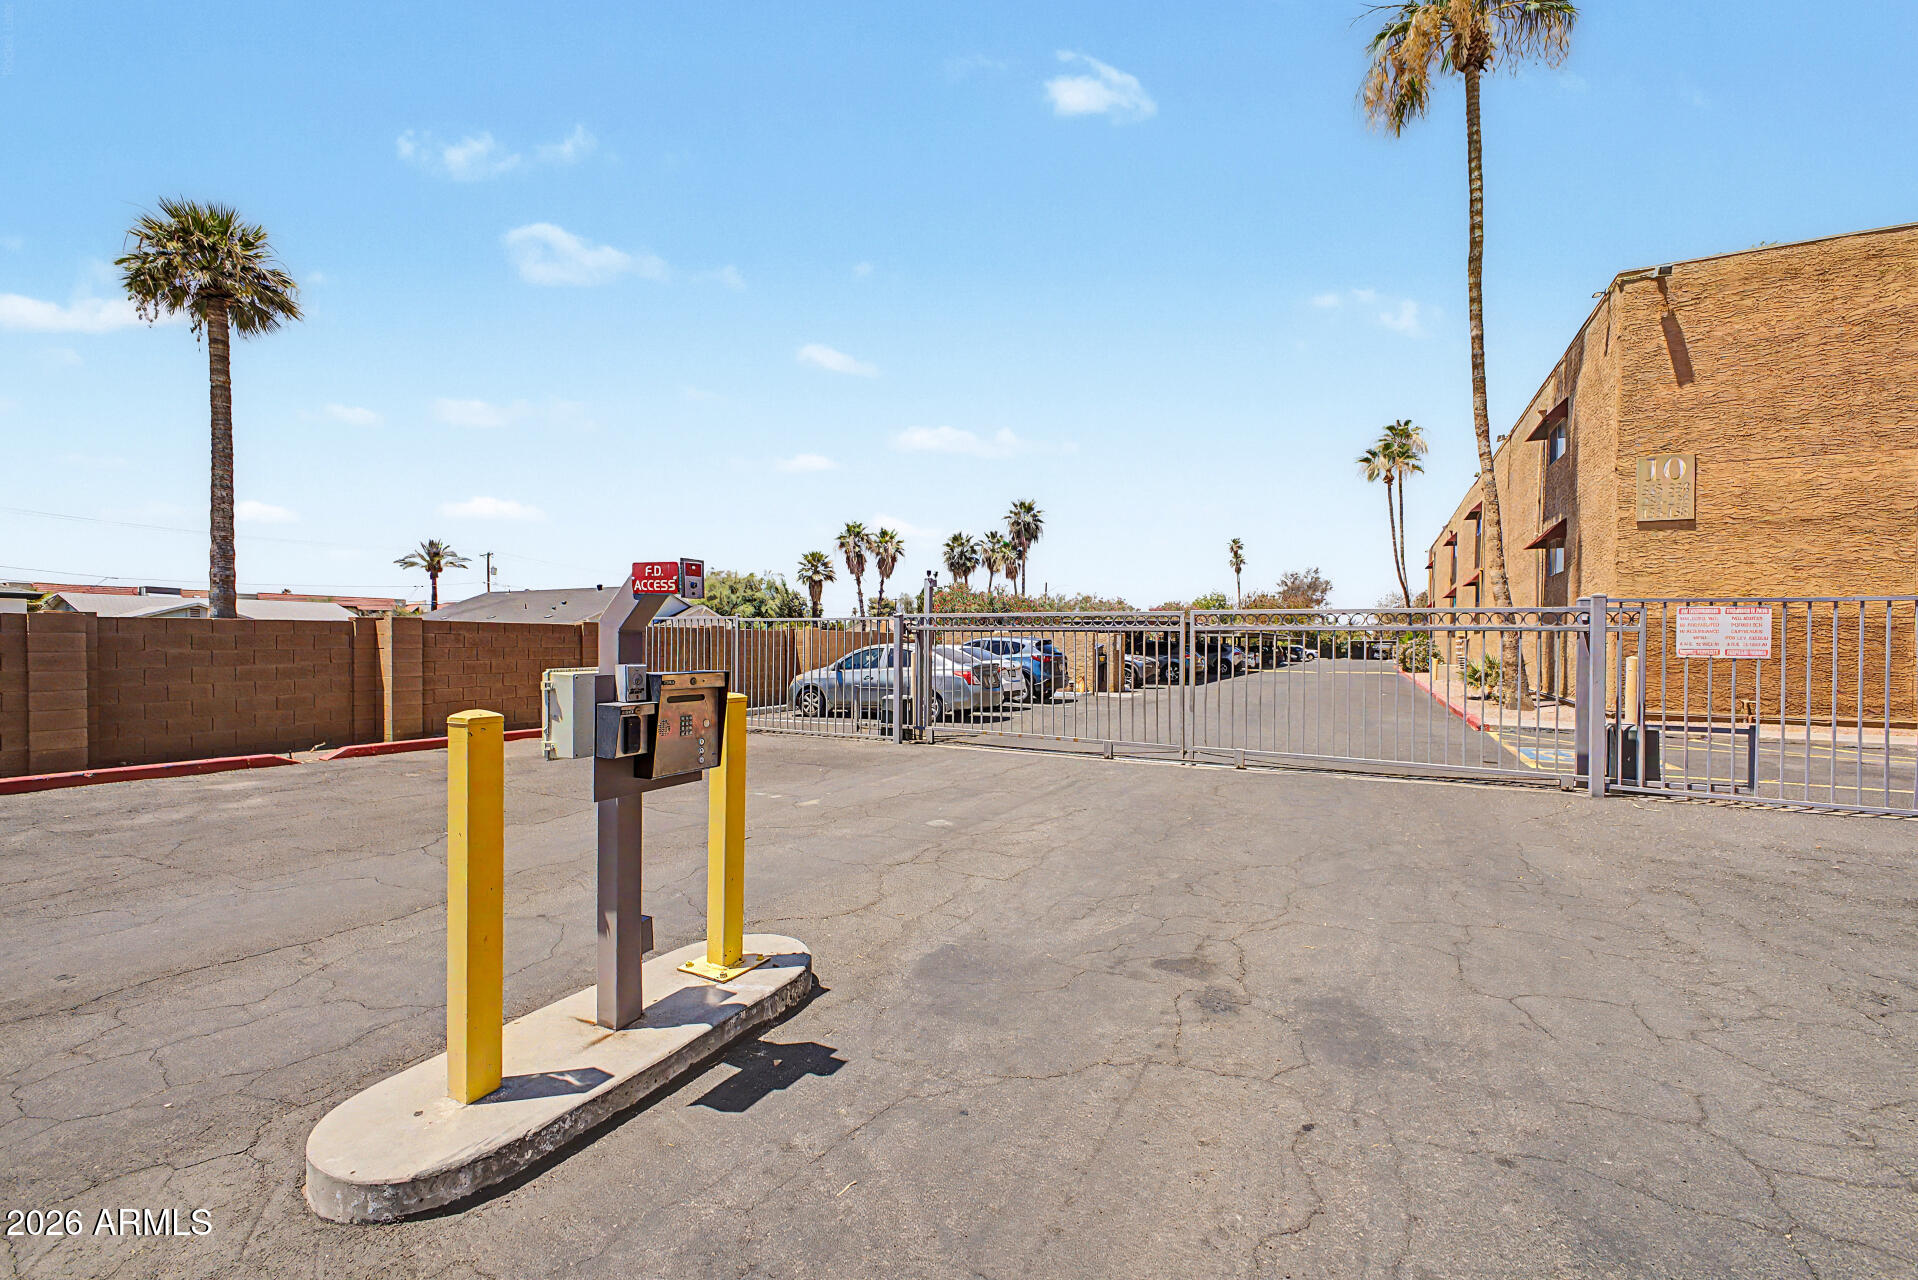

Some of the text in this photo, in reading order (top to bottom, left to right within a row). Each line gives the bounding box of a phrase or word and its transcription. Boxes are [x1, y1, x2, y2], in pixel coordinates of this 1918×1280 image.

[1645, 456, 1687, 481] 10
[645, 565, 664, 577] F.D.
[633, 579, 676, 591] ACCESS
